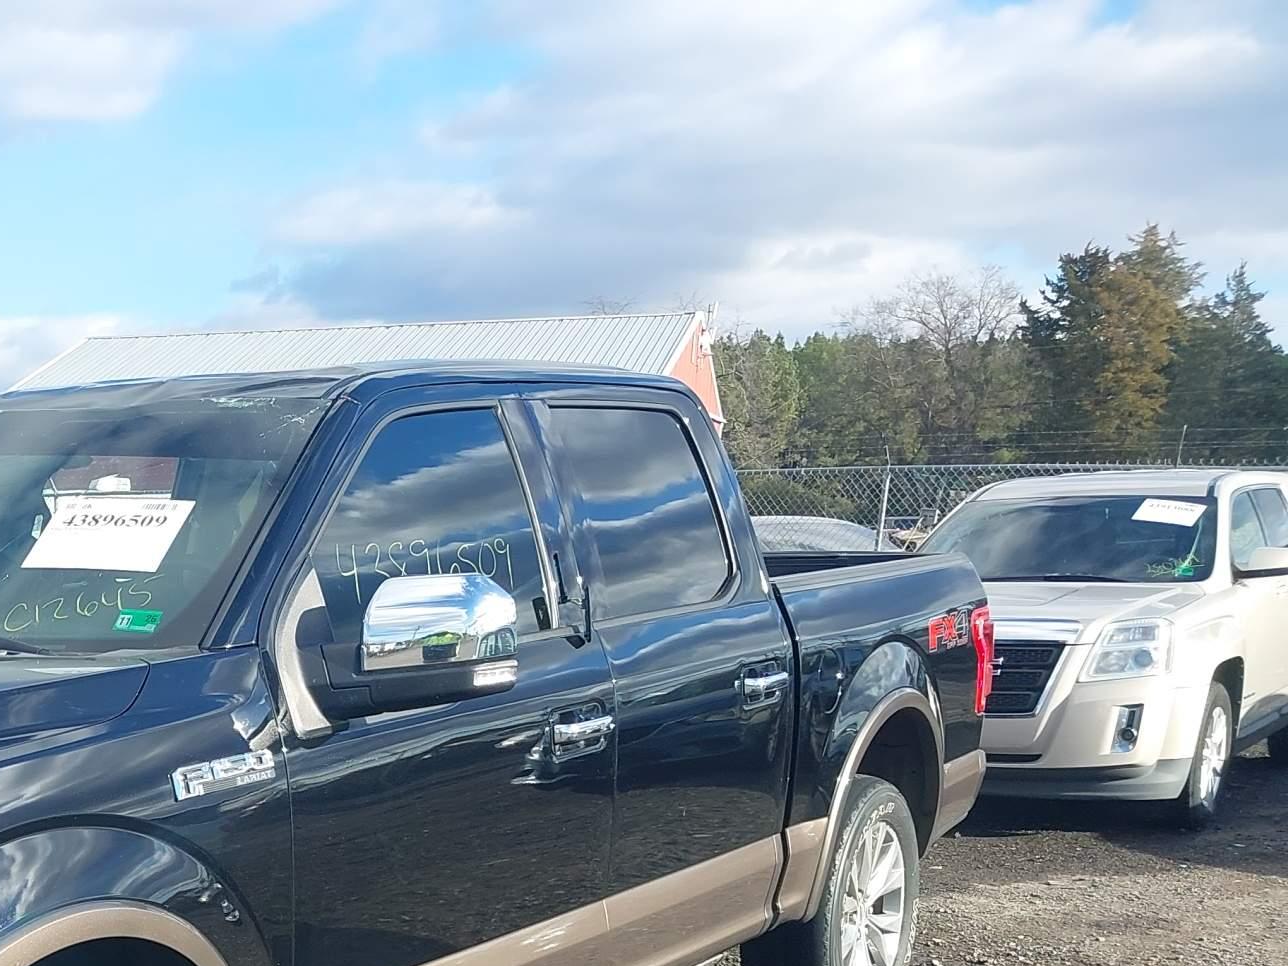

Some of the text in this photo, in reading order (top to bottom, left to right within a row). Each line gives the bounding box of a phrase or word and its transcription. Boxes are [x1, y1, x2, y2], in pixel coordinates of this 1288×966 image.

[63, 513, 168, 528] 43896509
[119, 616, 132, 627] 11
[928, 608, 969, 653] FX4
[236, 768, 276, 785] LARIAT
